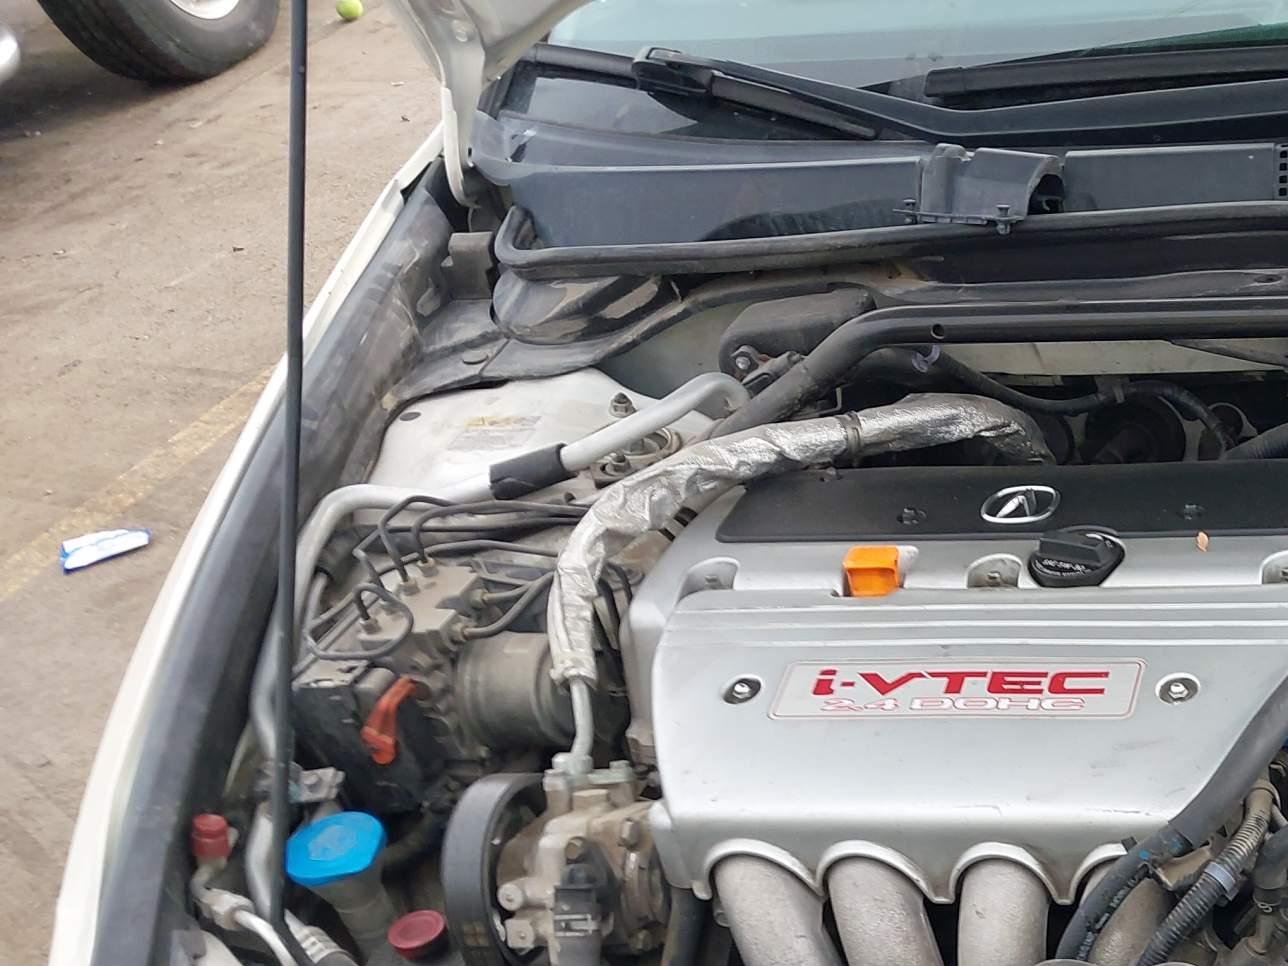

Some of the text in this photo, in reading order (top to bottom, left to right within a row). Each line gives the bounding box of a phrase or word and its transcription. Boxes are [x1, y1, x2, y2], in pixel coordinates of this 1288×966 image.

[811, 669, 1109, 696] i-VTEC
[820, 697, 1086, 713] 2.4 DOHC
